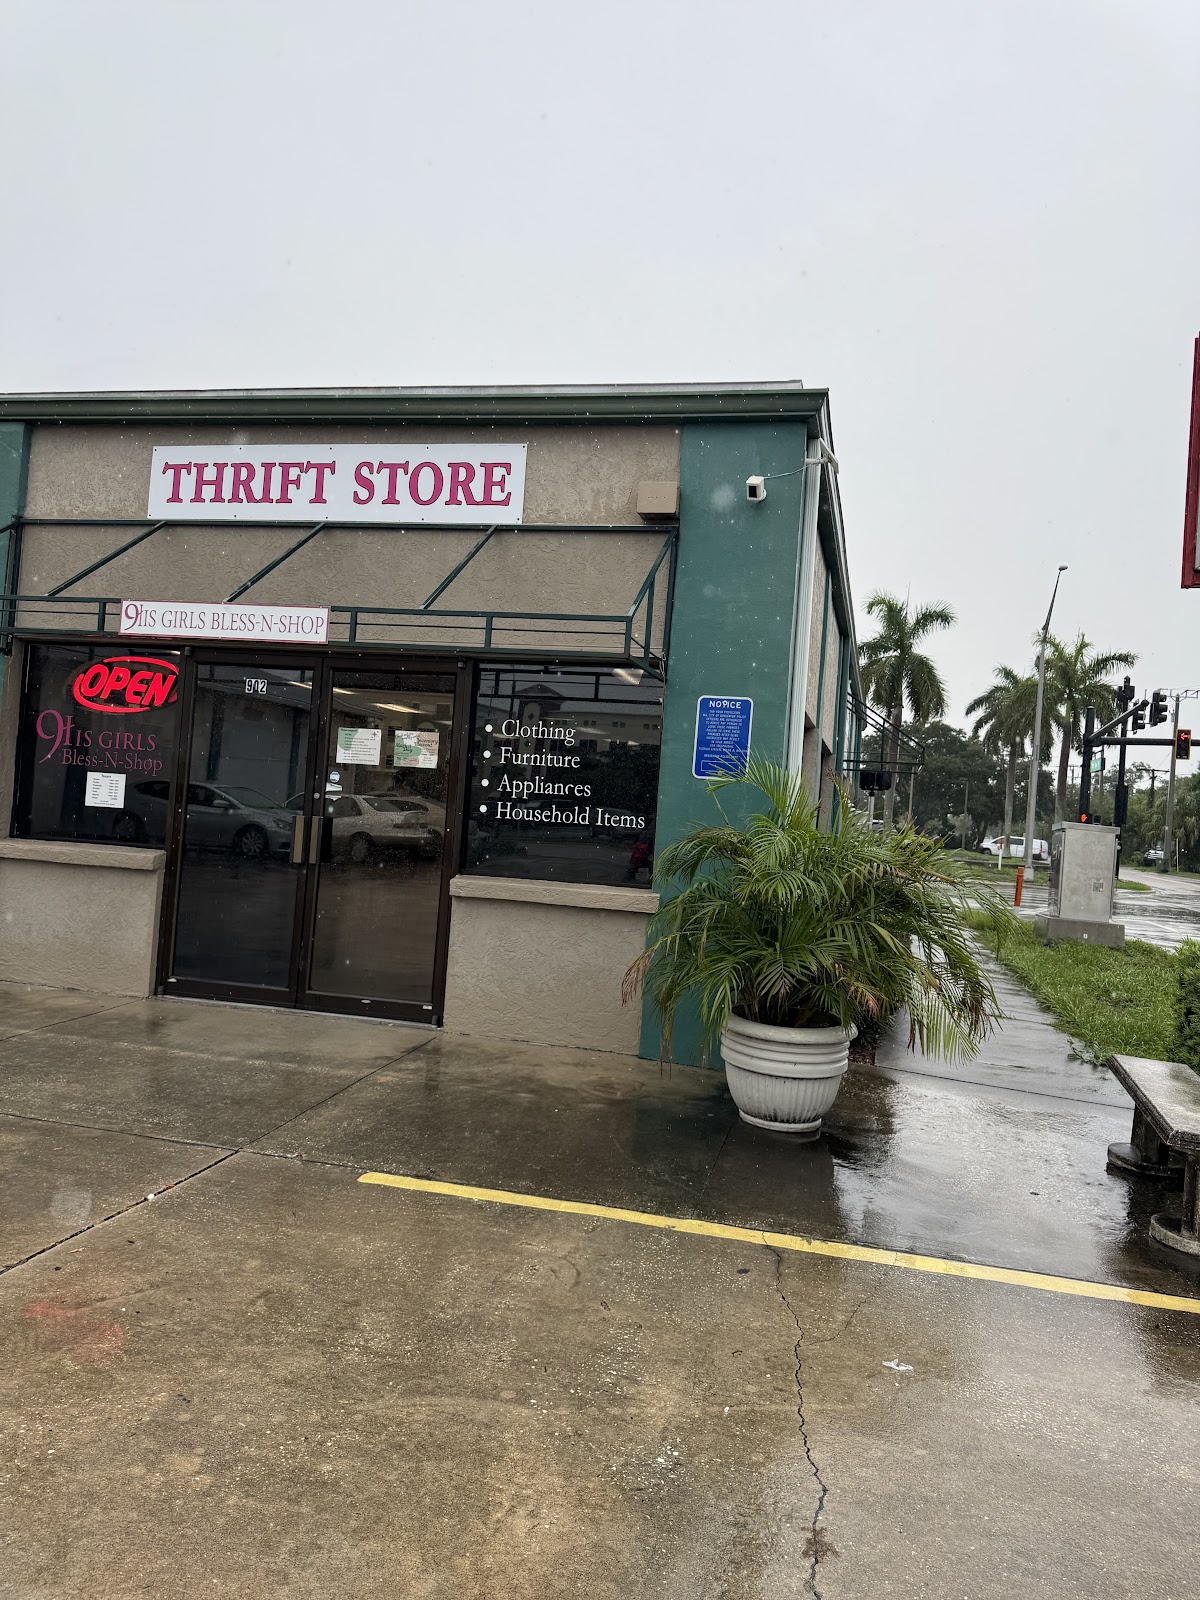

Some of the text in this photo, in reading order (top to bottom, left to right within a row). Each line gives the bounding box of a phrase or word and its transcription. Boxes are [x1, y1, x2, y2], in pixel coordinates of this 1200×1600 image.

[162, 460, 512, 506] THRIFT STORE
[161, 610, 206, 630] GIRLS
[210, 613, 325, 635] BLESS-N-SHOP
[81, 663, 176, 707] OPEN
[245, 678, 267, 694] 902
[98, 731, 156, 751] GIRLS
[501, 719, 576, 747] Clothing
[61, 748, 163, 777] Bless-N-Shop
[499, 746, 581, 769] Furniture
[497, 773, 592, 800] Appliances
[495, 801, 646, 829] Household Items
